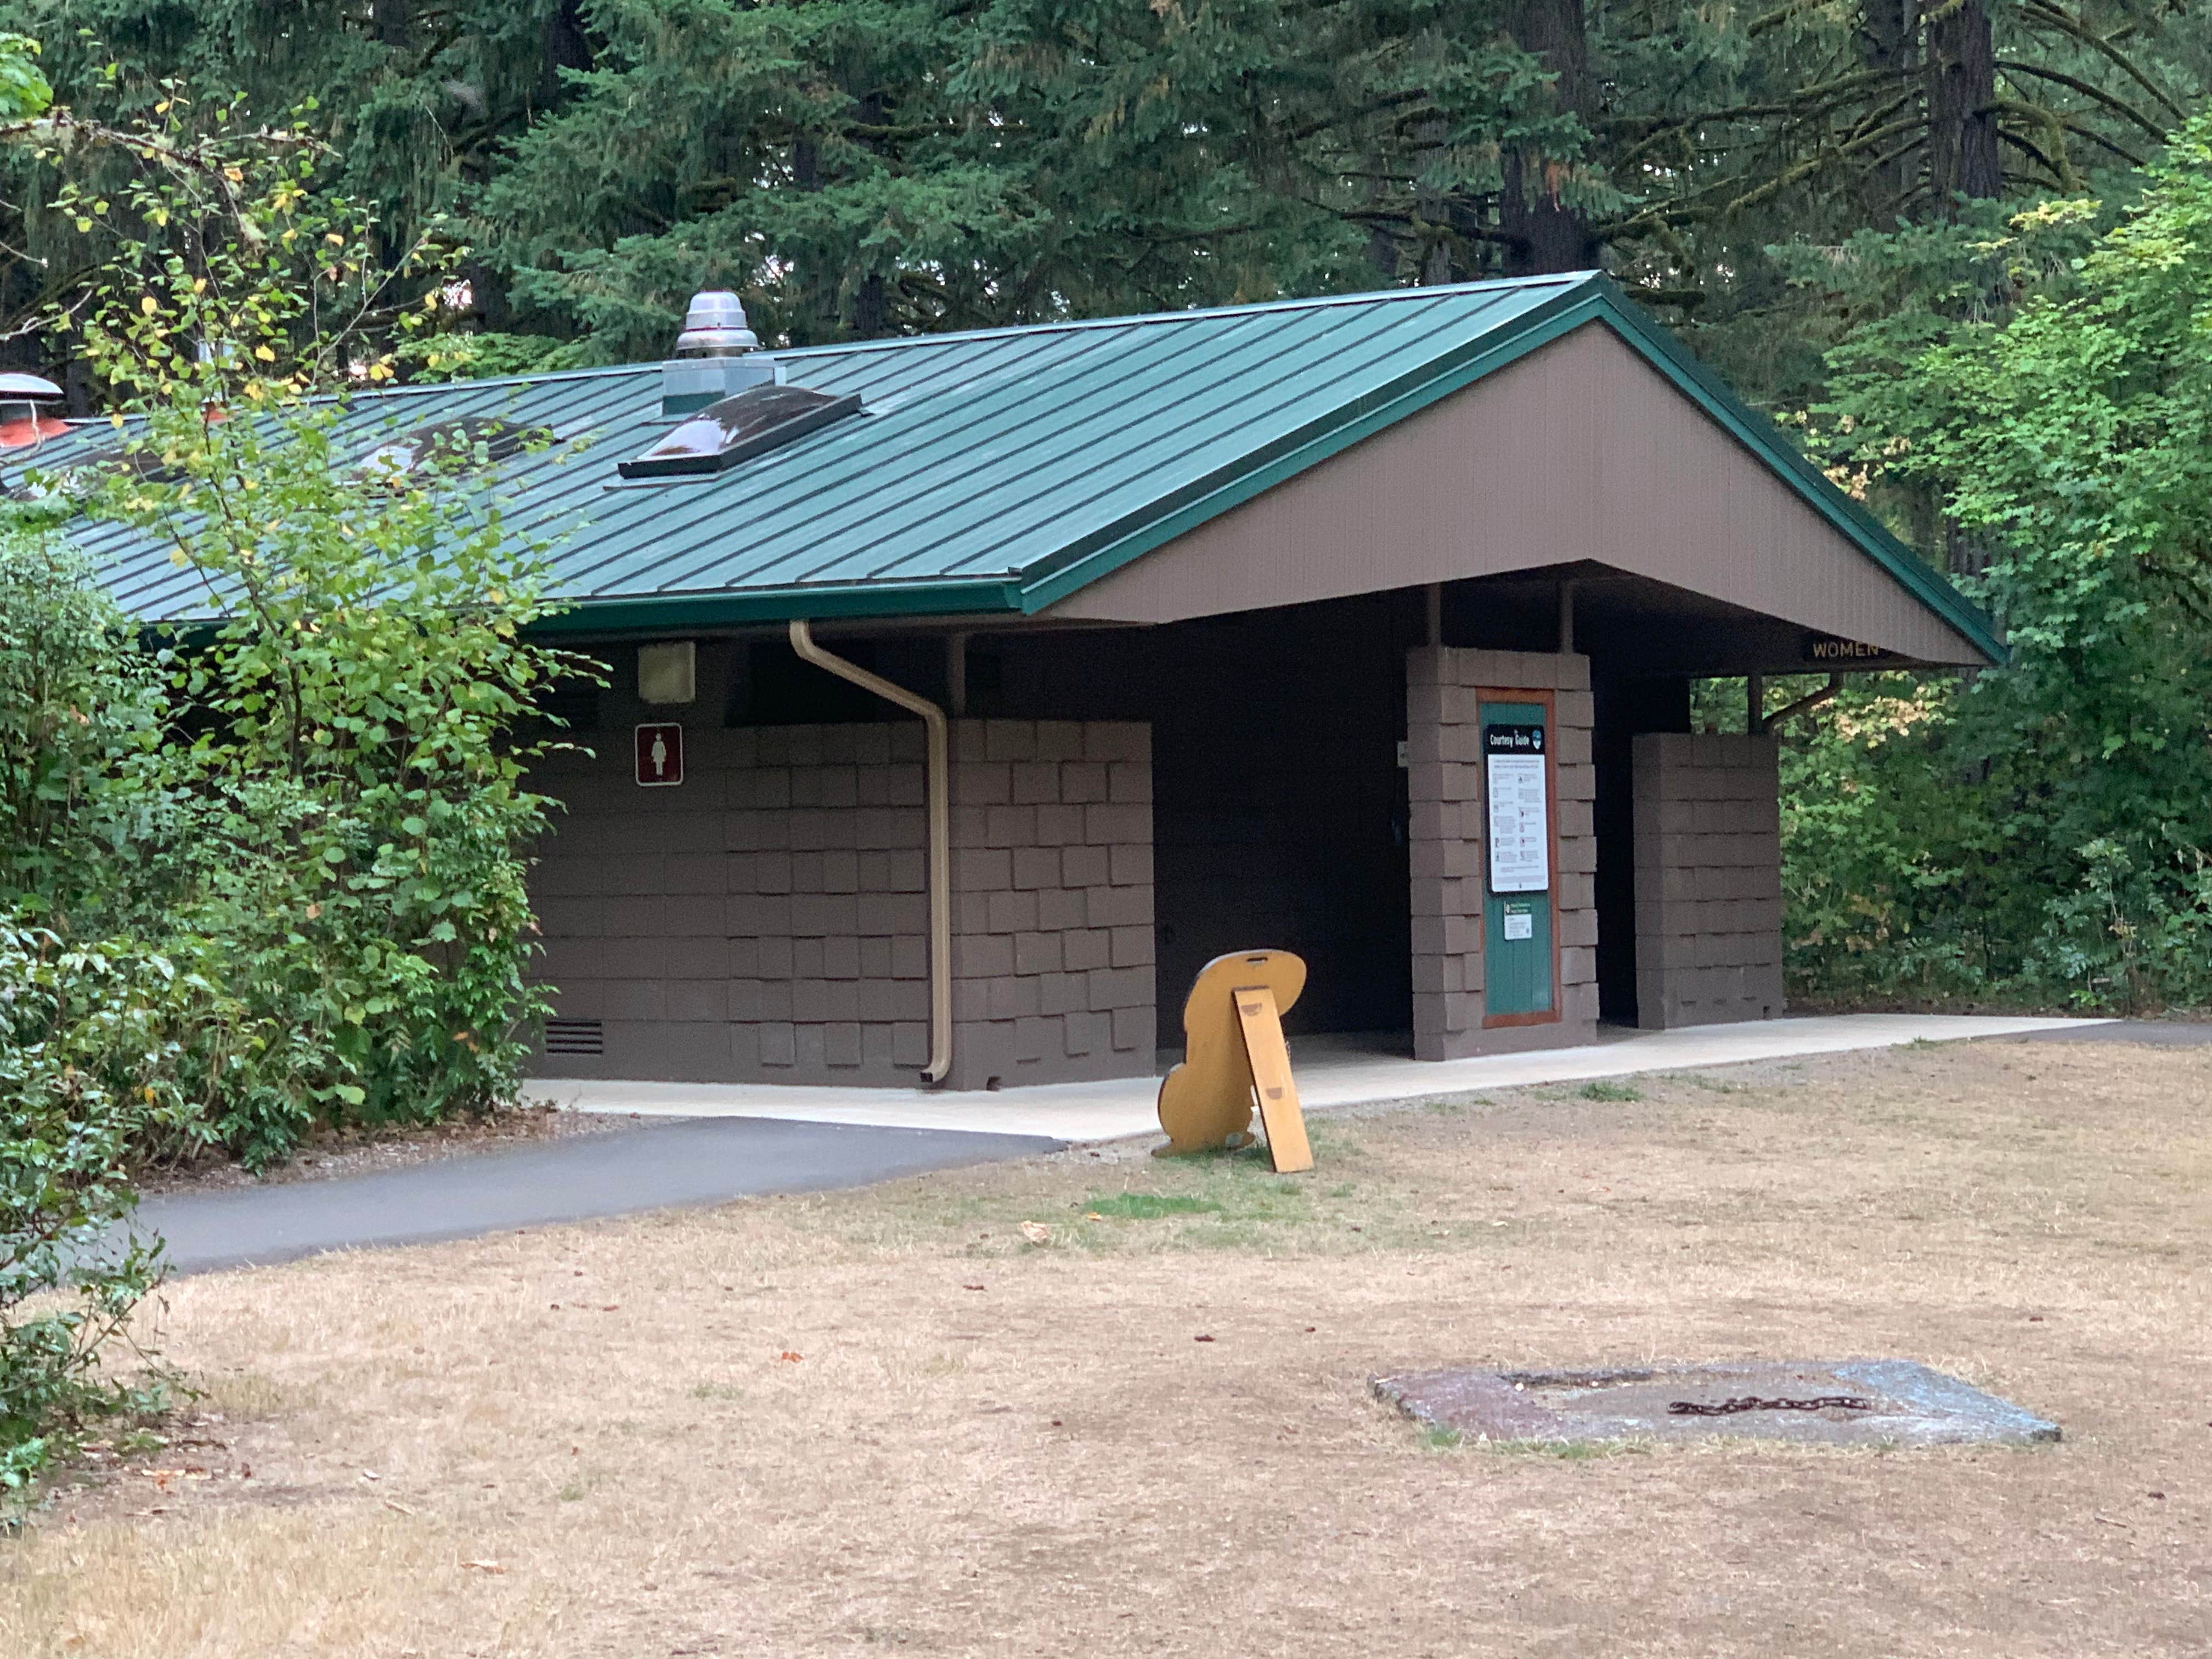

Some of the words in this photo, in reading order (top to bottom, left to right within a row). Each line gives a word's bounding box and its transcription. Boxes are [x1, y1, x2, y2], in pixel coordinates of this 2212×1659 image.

[1813, 642, 1879, 658] WOMEN
[1490, 734, 1513, 748] Courtesy
[1515, 734, 1530, 746] Guide
